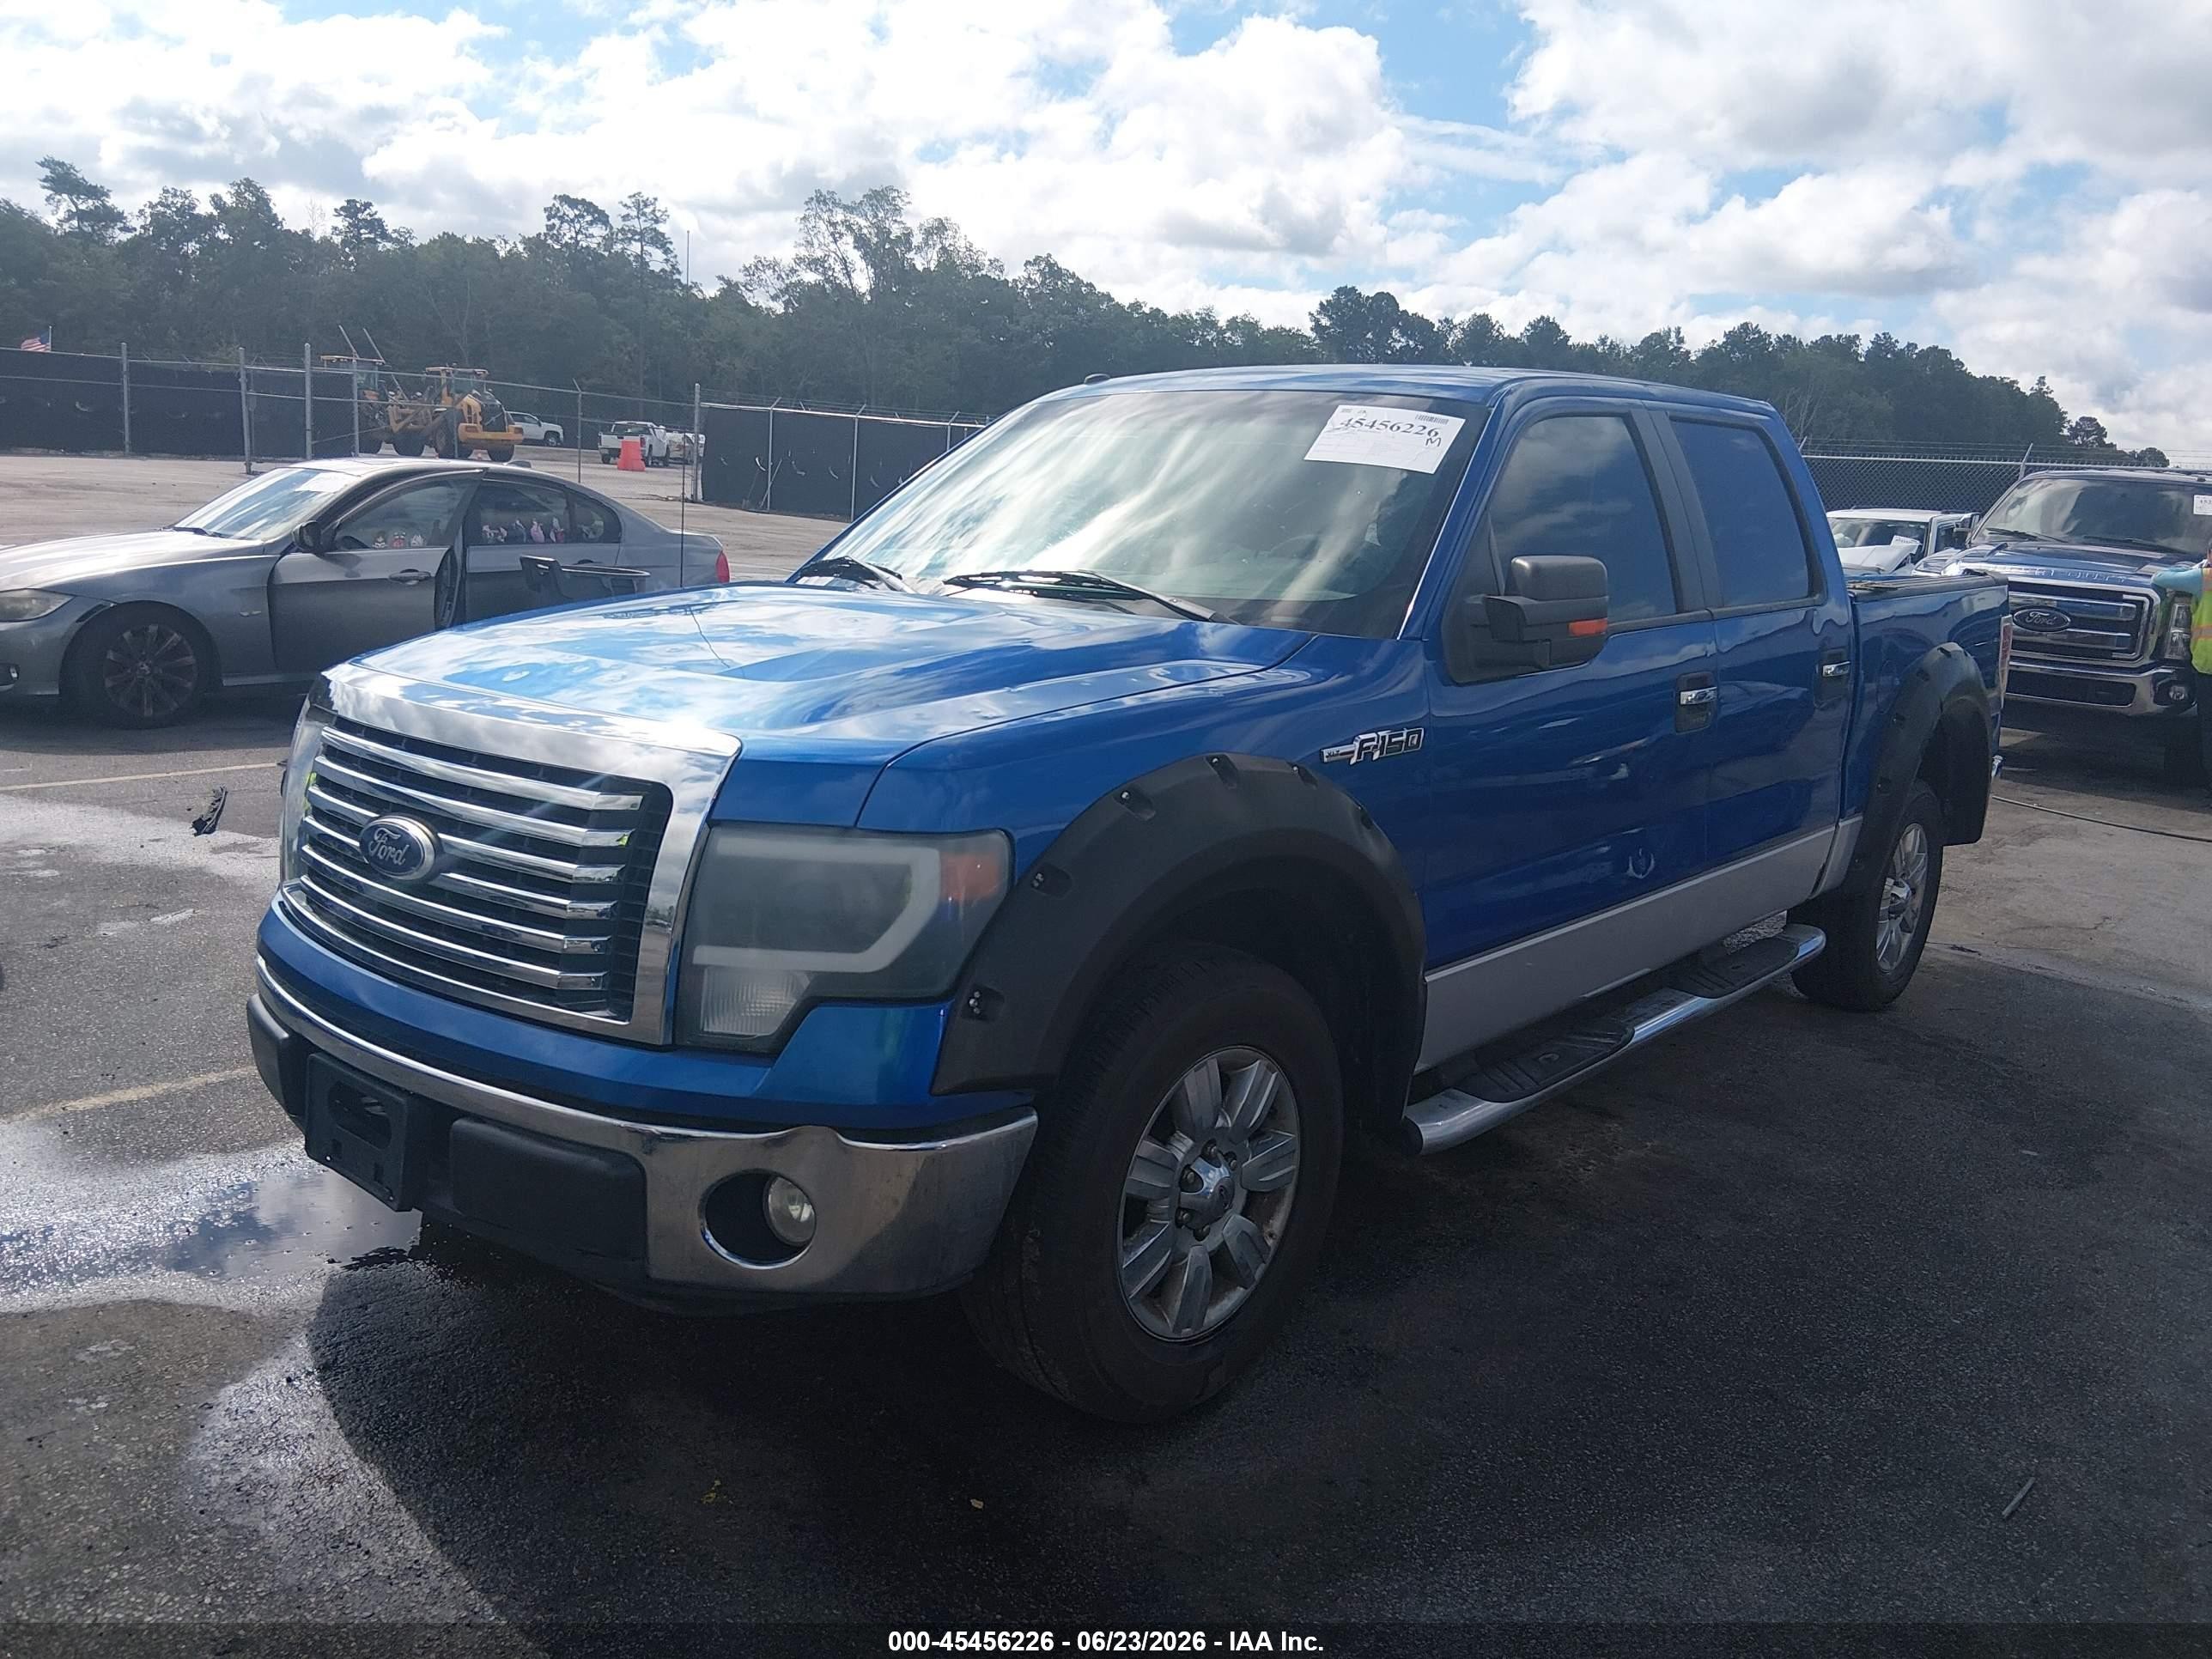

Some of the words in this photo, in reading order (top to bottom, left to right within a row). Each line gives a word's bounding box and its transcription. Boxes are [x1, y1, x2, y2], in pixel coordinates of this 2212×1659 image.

[1340, 416, 1440, 438] 45456226
[1425, 437, 1442, 447] M
[2025, 611, 2057, 626] Ford
[368, 827, 410, 866] Ford
